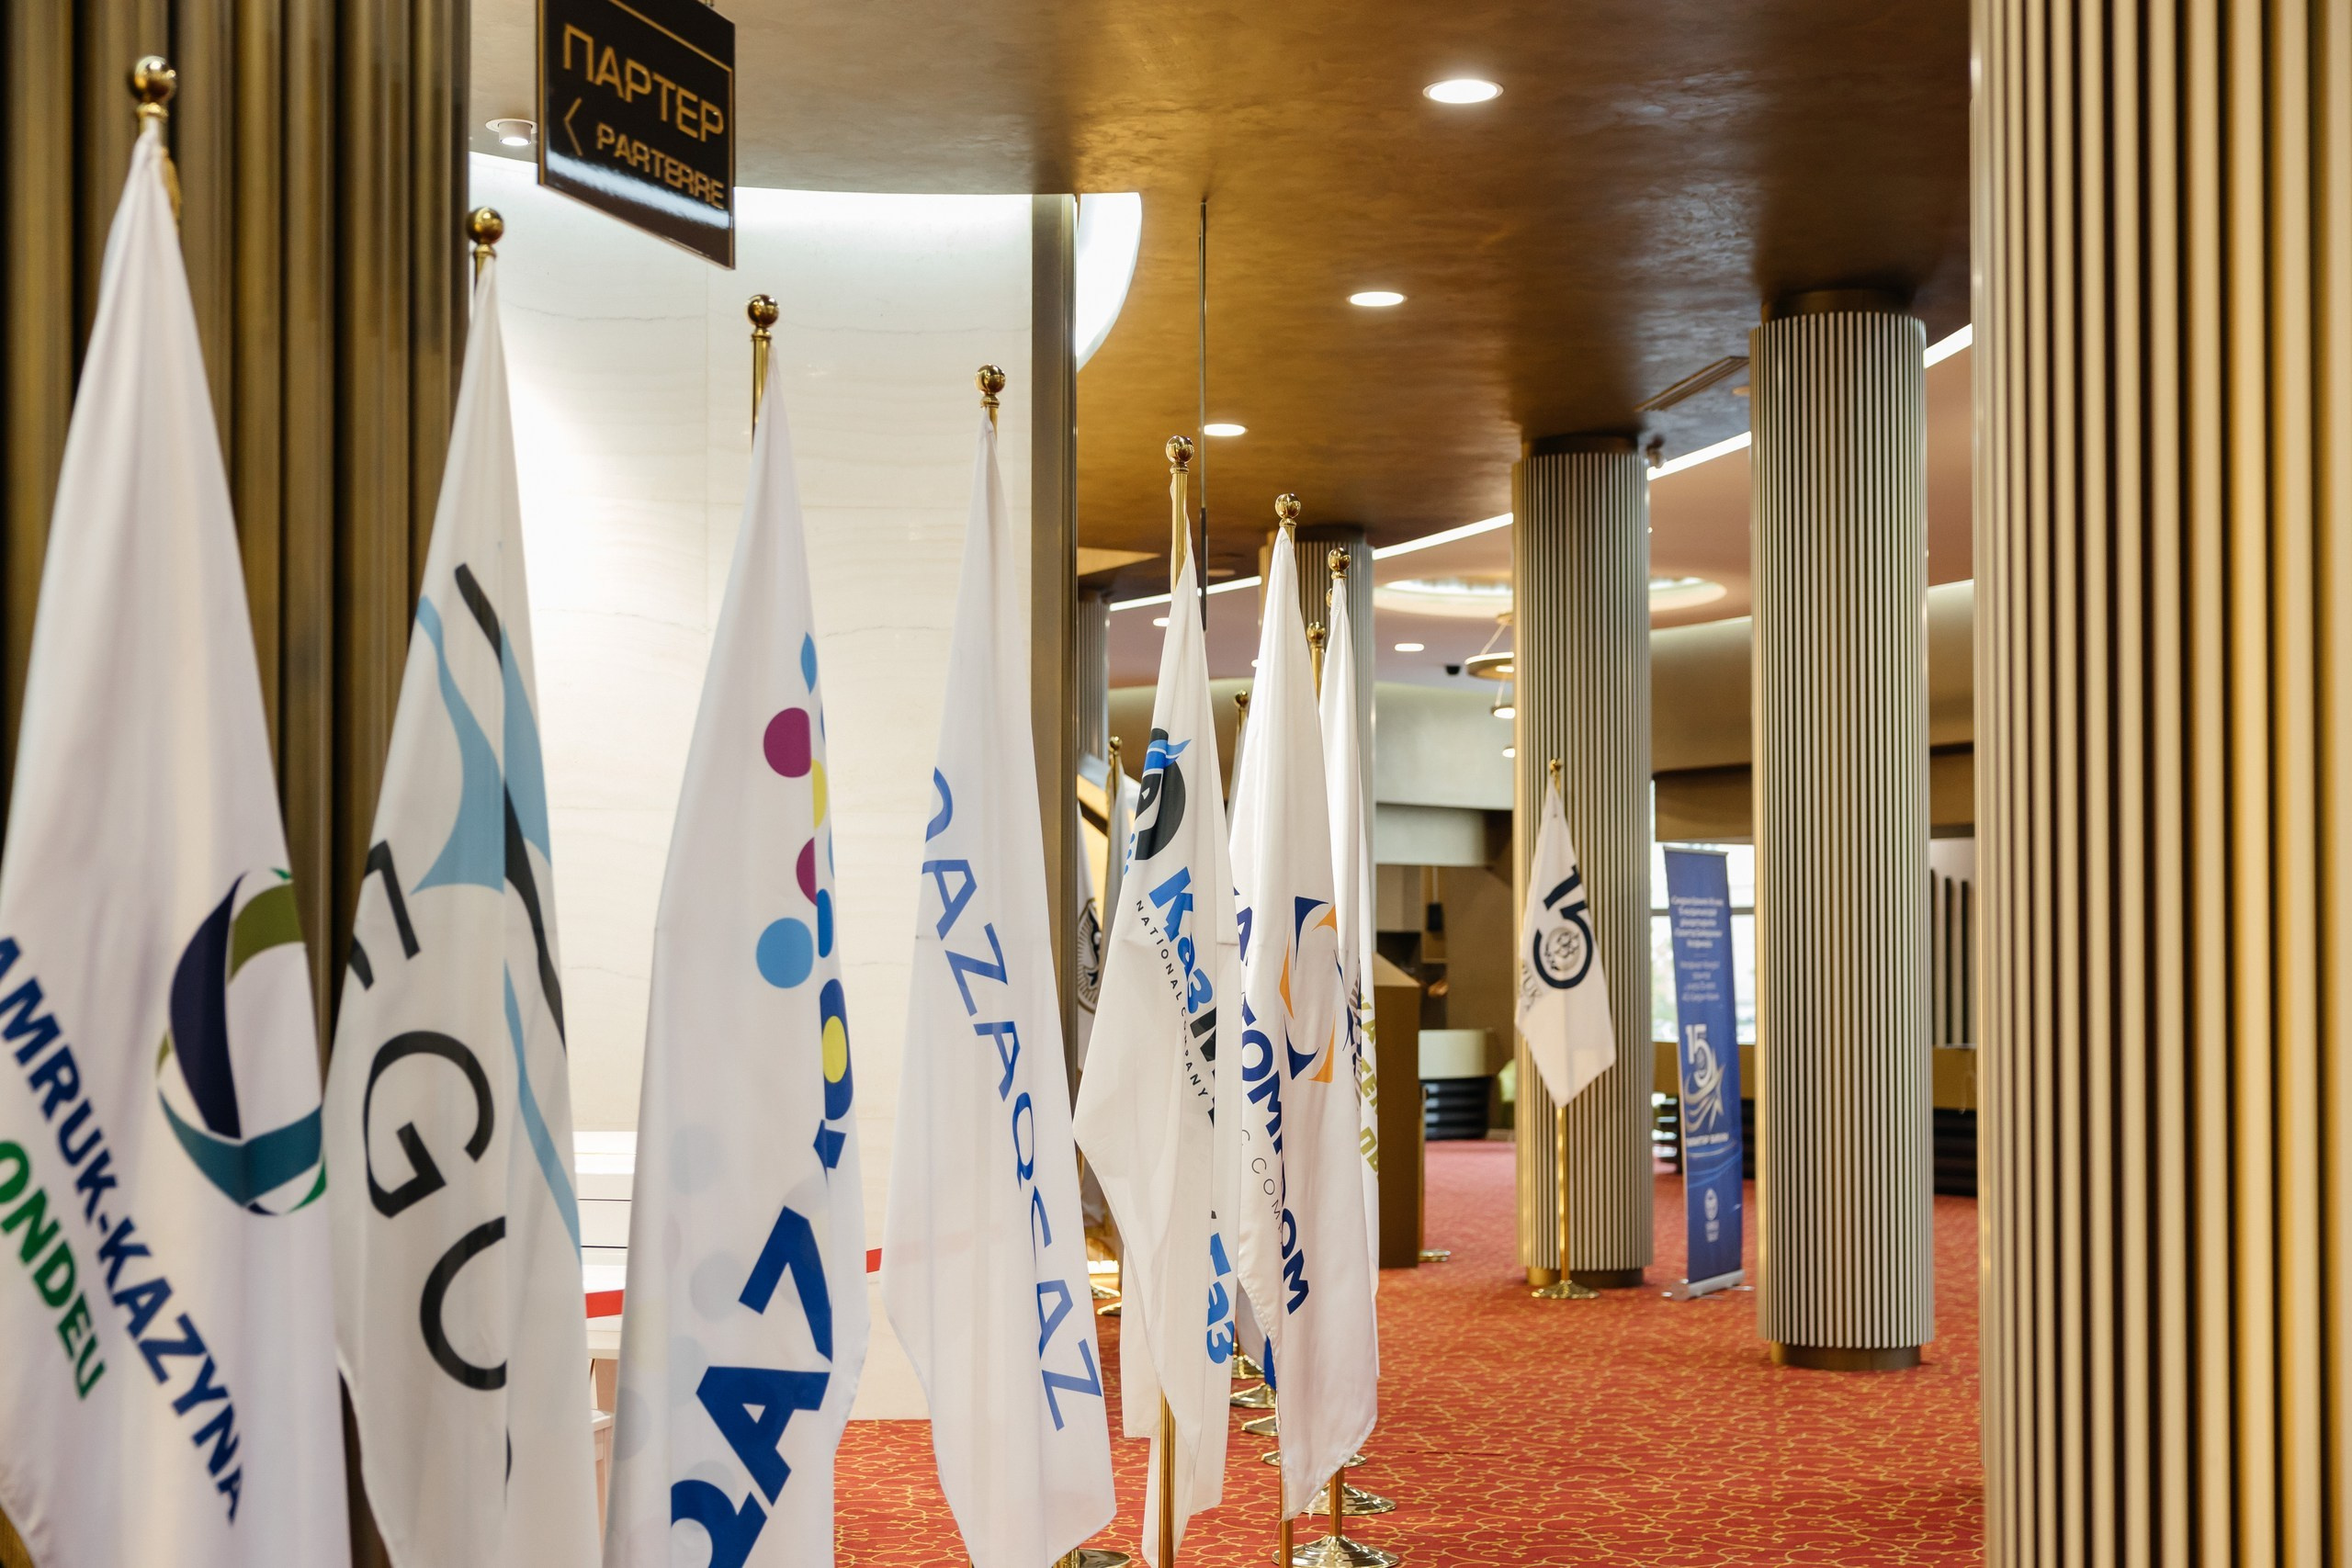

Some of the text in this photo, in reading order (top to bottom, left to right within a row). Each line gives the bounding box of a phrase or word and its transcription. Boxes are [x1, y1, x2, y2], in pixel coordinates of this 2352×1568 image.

[562, 23, 724, 142] ПАРТЕР
[596, 121, 725, 210] PARTERRE
[1136, 900, 1183, 1001] NATIONAL
[1532, 864, 1593, 989] 15
[1685, 1023, 1712, 1089] 15
[0, 1139, 107, 1402] ONDEU
